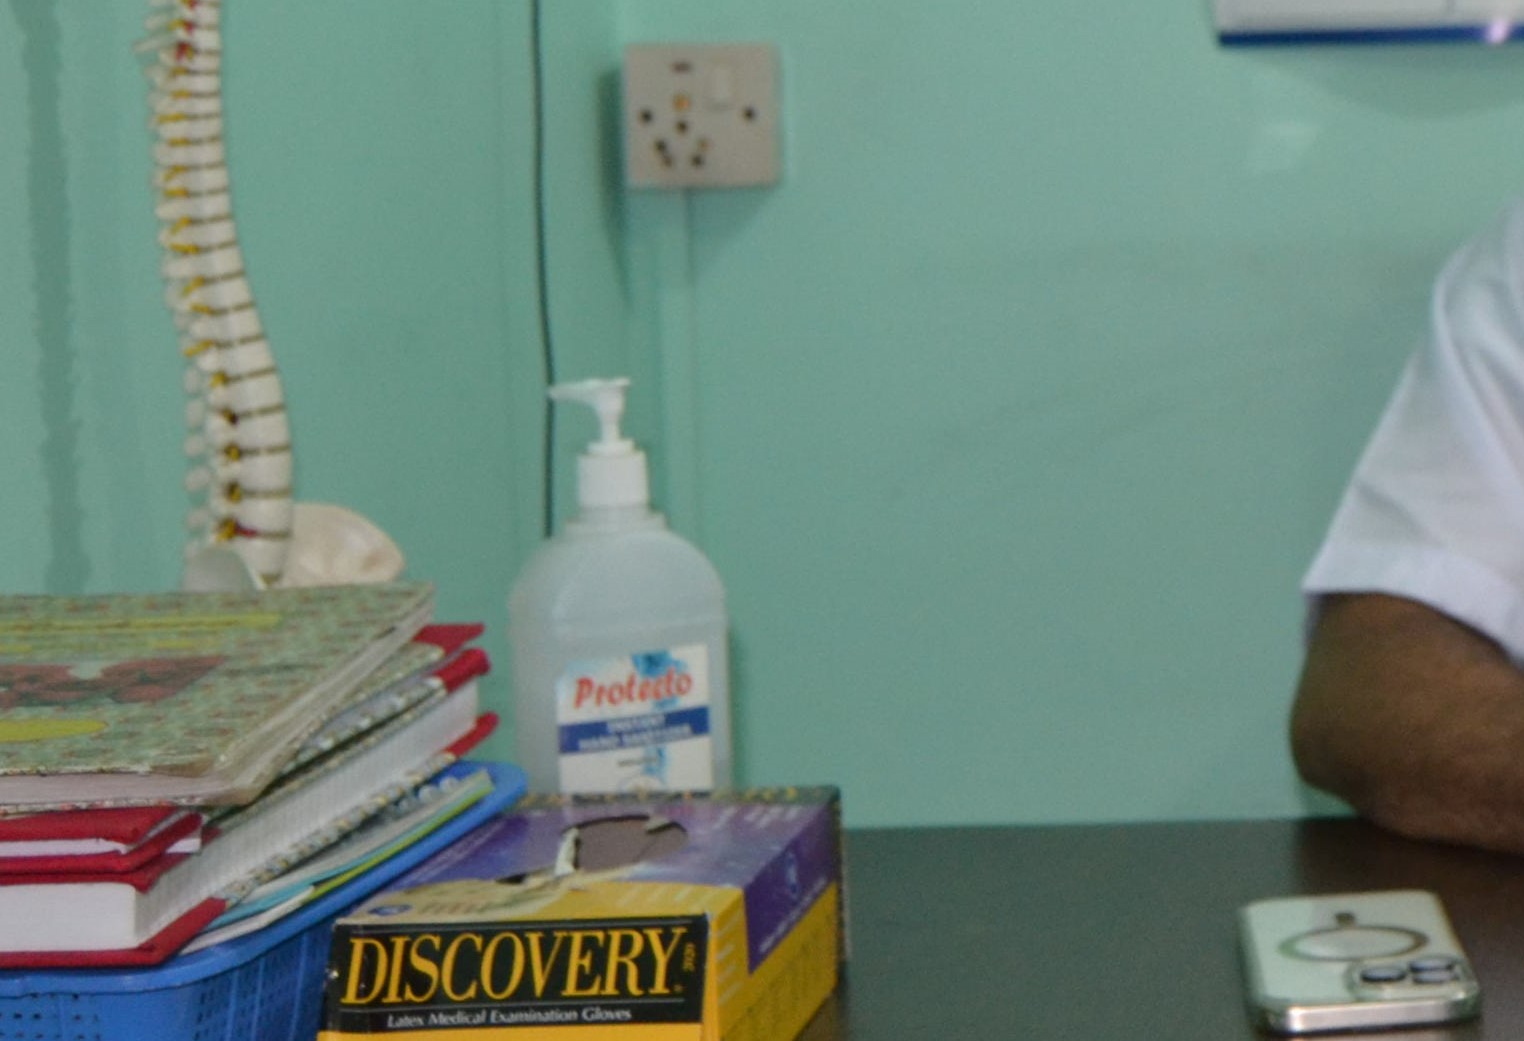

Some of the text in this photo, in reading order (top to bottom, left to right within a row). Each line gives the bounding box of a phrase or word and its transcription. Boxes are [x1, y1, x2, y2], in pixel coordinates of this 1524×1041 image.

[573, 666, 694, 710] Protecto
[340, 927, 687, 1004] DISCOVERY
[387, 1005, 633, 1029] Latex Medical Examination Gloves
